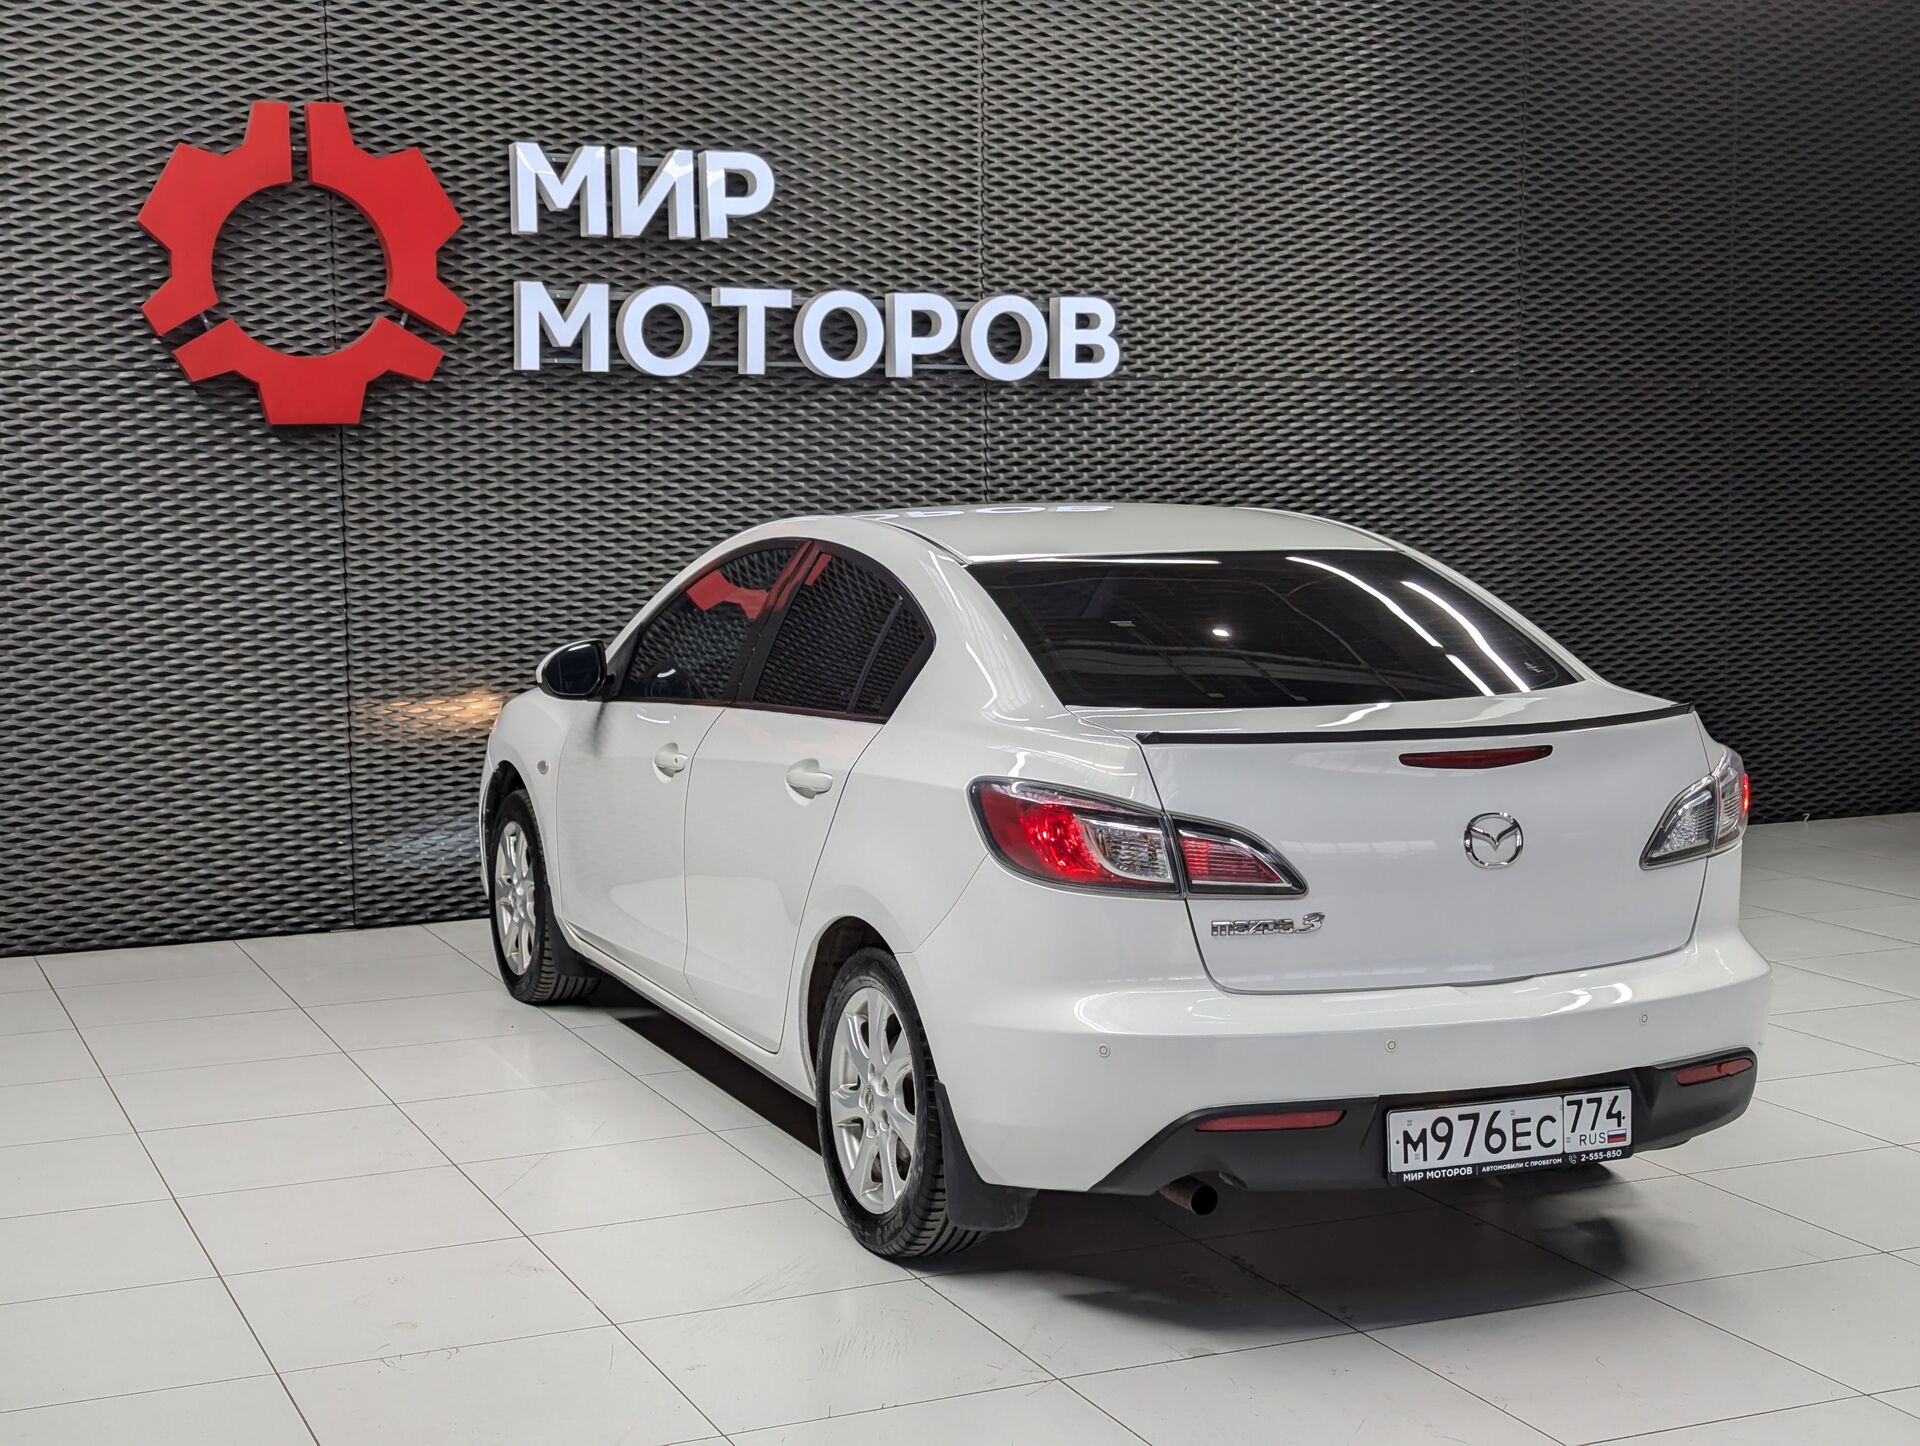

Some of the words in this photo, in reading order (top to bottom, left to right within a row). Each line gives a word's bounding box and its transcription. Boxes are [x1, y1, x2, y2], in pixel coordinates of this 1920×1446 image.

[509, 142, 775, 241] МИР
[513, 281, 1120, 381] МОТОРОВ
[1566, 1095, 1622, 1134] 774
[1579, 1132, 1606, 1147] RUS
[1403, 1172, 1424, 1182] МИР
[1426, 1166, 1473, 1180] МОТОРОВ
[1481, 1162, 1524, 1173] АВТОМОБИЛИ
[1530, 1158, 1562, 1167] ПРОБЕГОМ
[1580, 1149, 1623, 1162] 2-555-850
